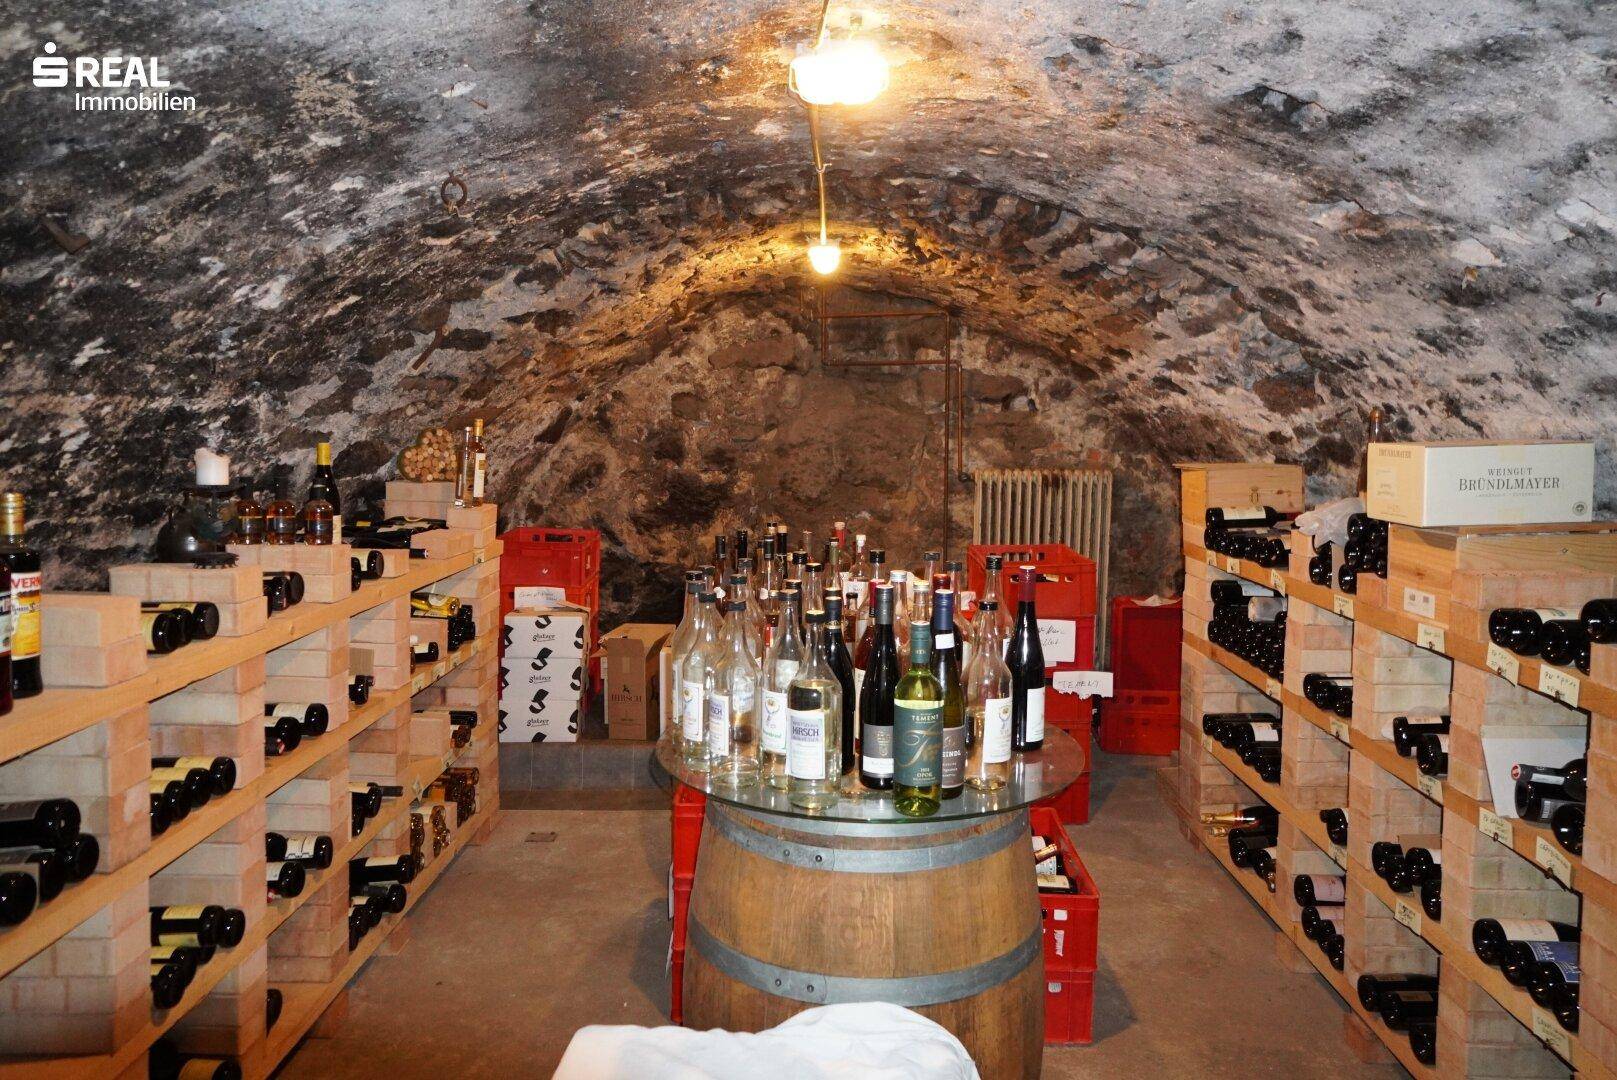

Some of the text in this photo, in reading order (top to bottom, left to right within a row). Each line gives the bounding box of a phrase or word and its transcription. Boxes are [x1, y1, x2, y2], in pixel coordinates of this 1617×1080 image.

[1487, 467, 1533, 476] WEINGUT
[1459, 476, 1560, 491] BRÜNDLMAYER
[911, 714, 939, 722] TEMENT
